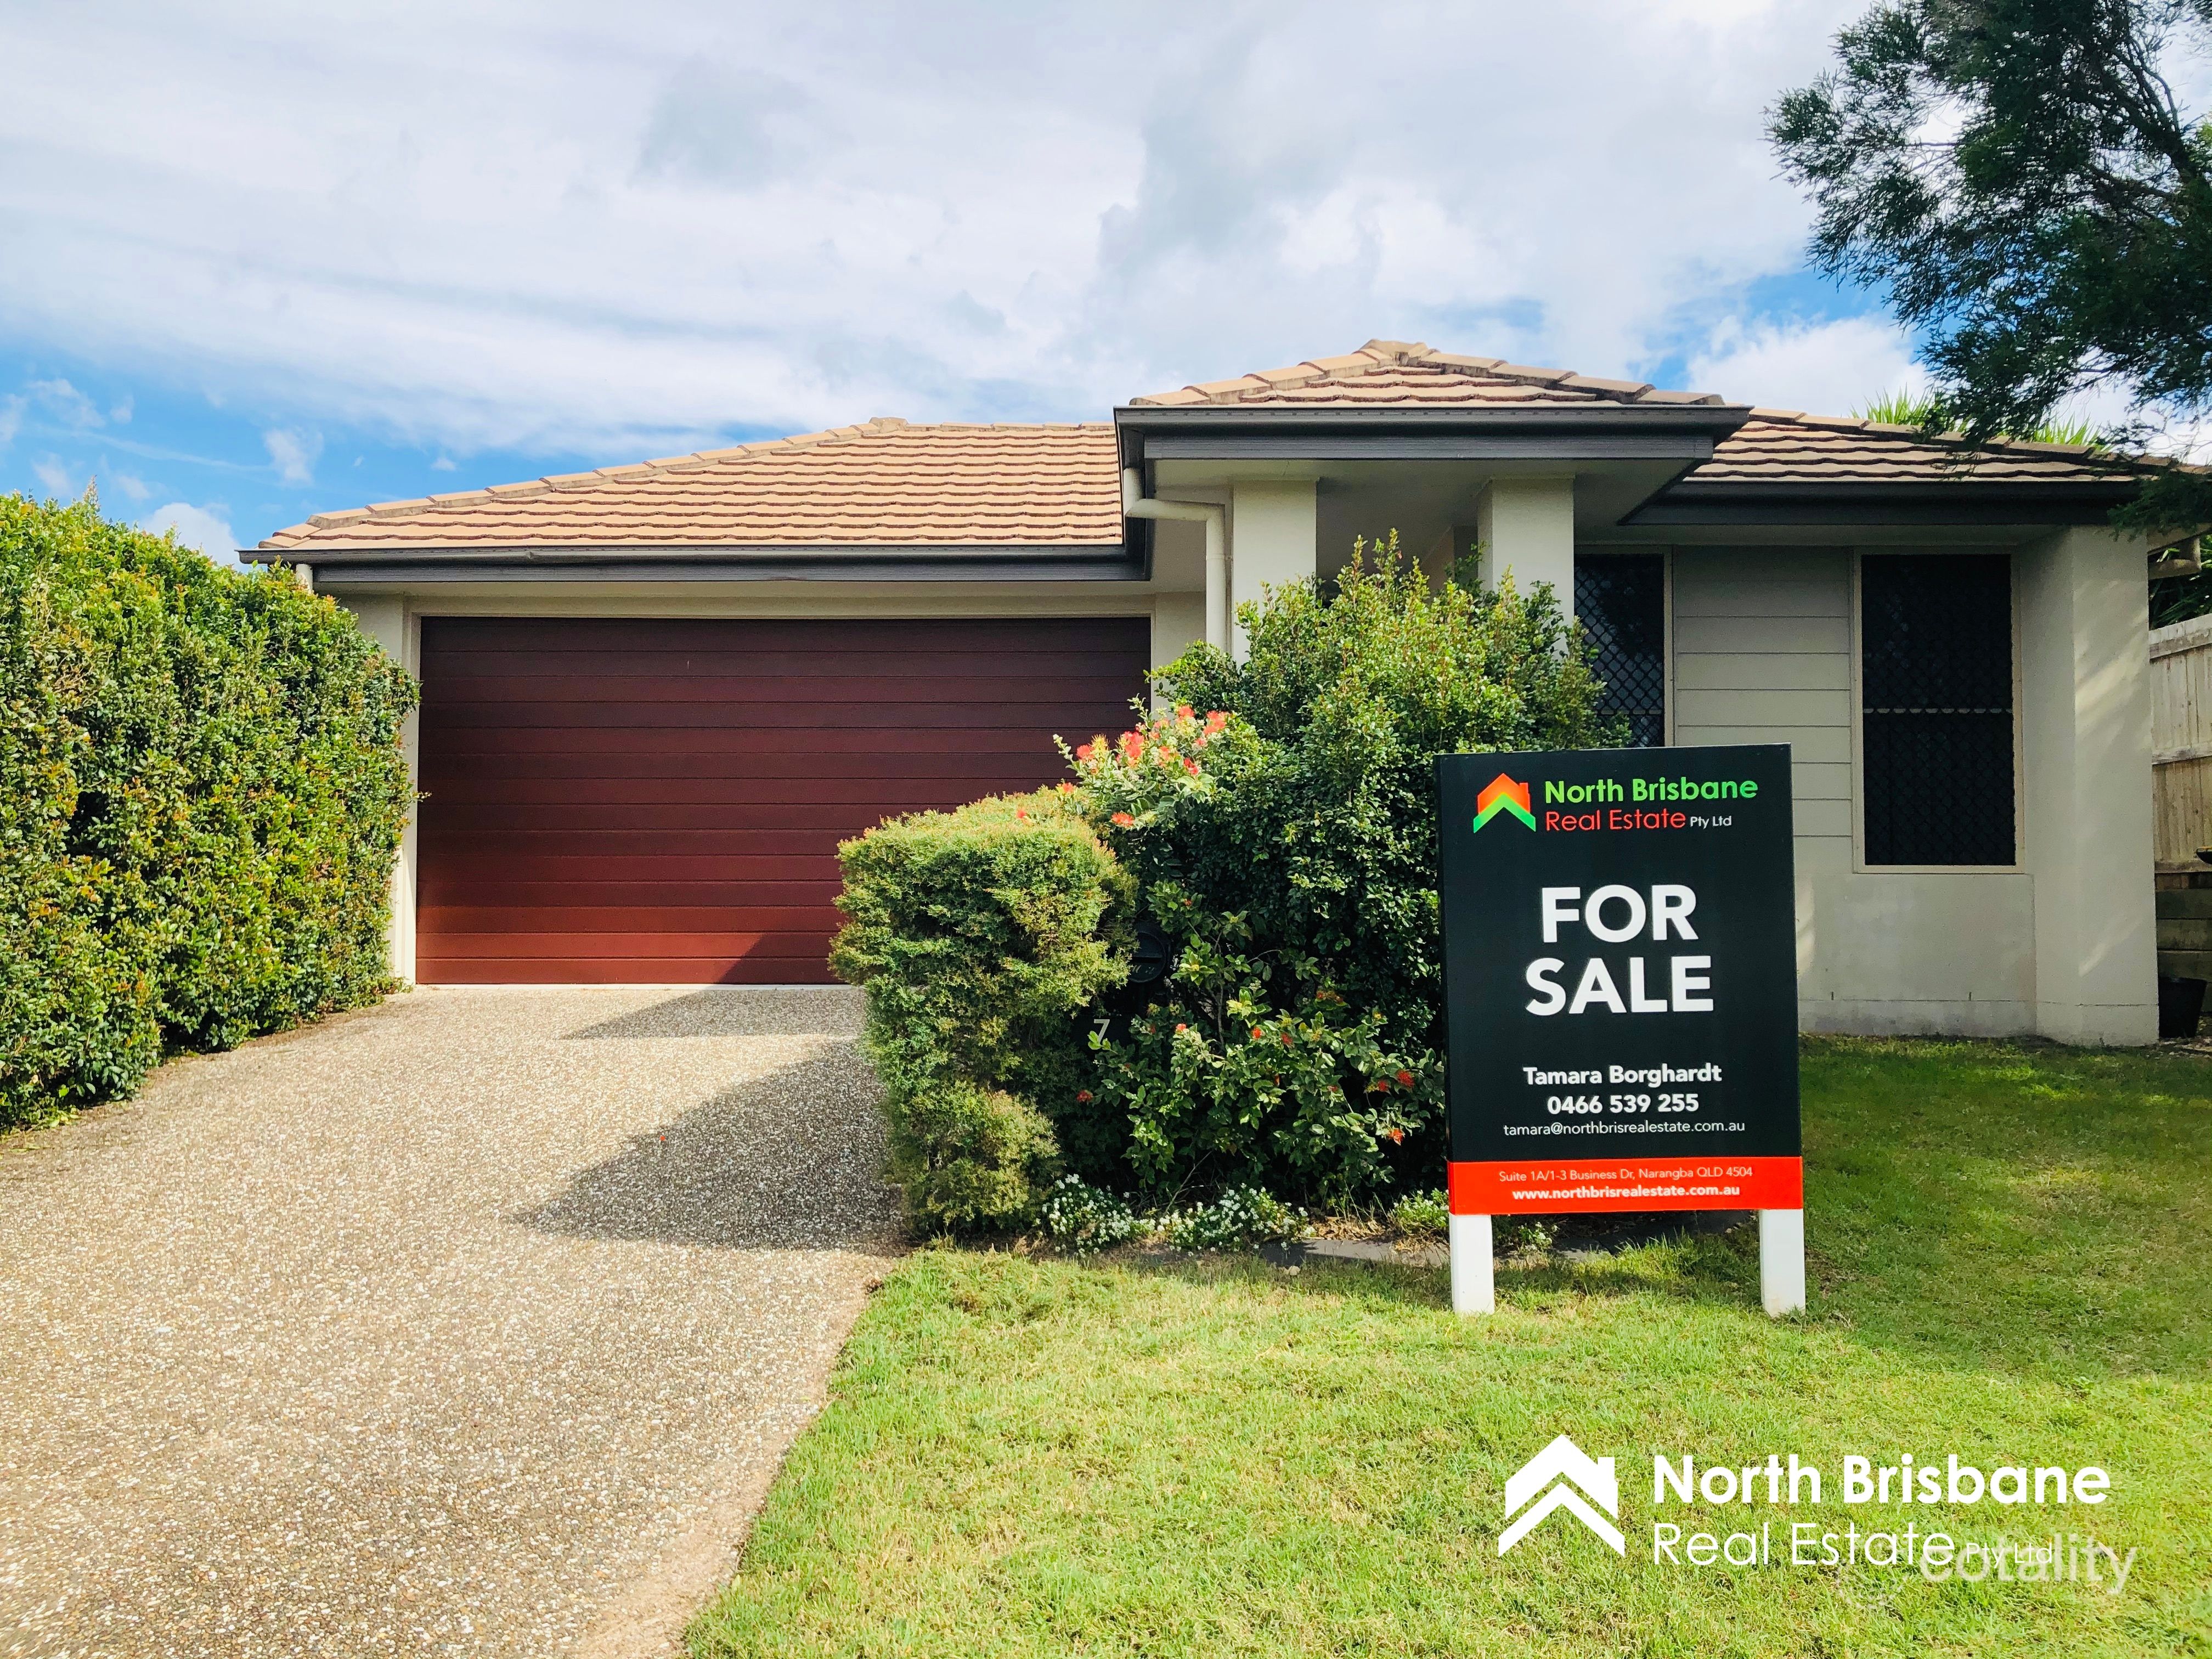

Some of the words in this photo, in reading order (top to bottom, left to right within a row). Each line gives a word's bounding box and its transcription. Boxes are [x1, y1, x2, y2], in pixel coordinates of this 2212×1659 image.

[1545, 779, 1623, 803] North
[1633, 777, 1758, 801] Brisbane
[1547, 810, 1600, 831] Real
[1610, 809, 1685, 830] Estate
[1690, 816, 1709, 829] Pty
[1713, 816, 1731, 826] Ltd
[1542, 884, 1699, 943] FOR
[1525, 956, 1713, 1015] SALE
[1093, 1019, 1110, 1044] 7
[1523, 1067, 1602, 1085] Tamara
[1609, 1063, 1722, 1087] Borghardt
[1547, 1096, 1602, 1114] 0466
[1610, 1094, 1651, 1113] 539
[1658, 1094, 1699, 1111] 255
[1504, 1120, 1745, 1135] tamara@northbrisrealestate.com.au
[1499, 1171, 1526, 1181] Suite
[1531, 1170, 1566, 1180] 1A/1-3
[1570, 1170, 1617, 1180] Business
[1621, 1169, 1635, 1179] Dr,
[1639, 1167, 1693, 1180] Narangba
[1697, 1167, 1723, 1177] QLD
[1726, 1167, 1752, 1176] 4504
[1513, 1184, 1740, 1199] www.northbrisrealestate.com.au
